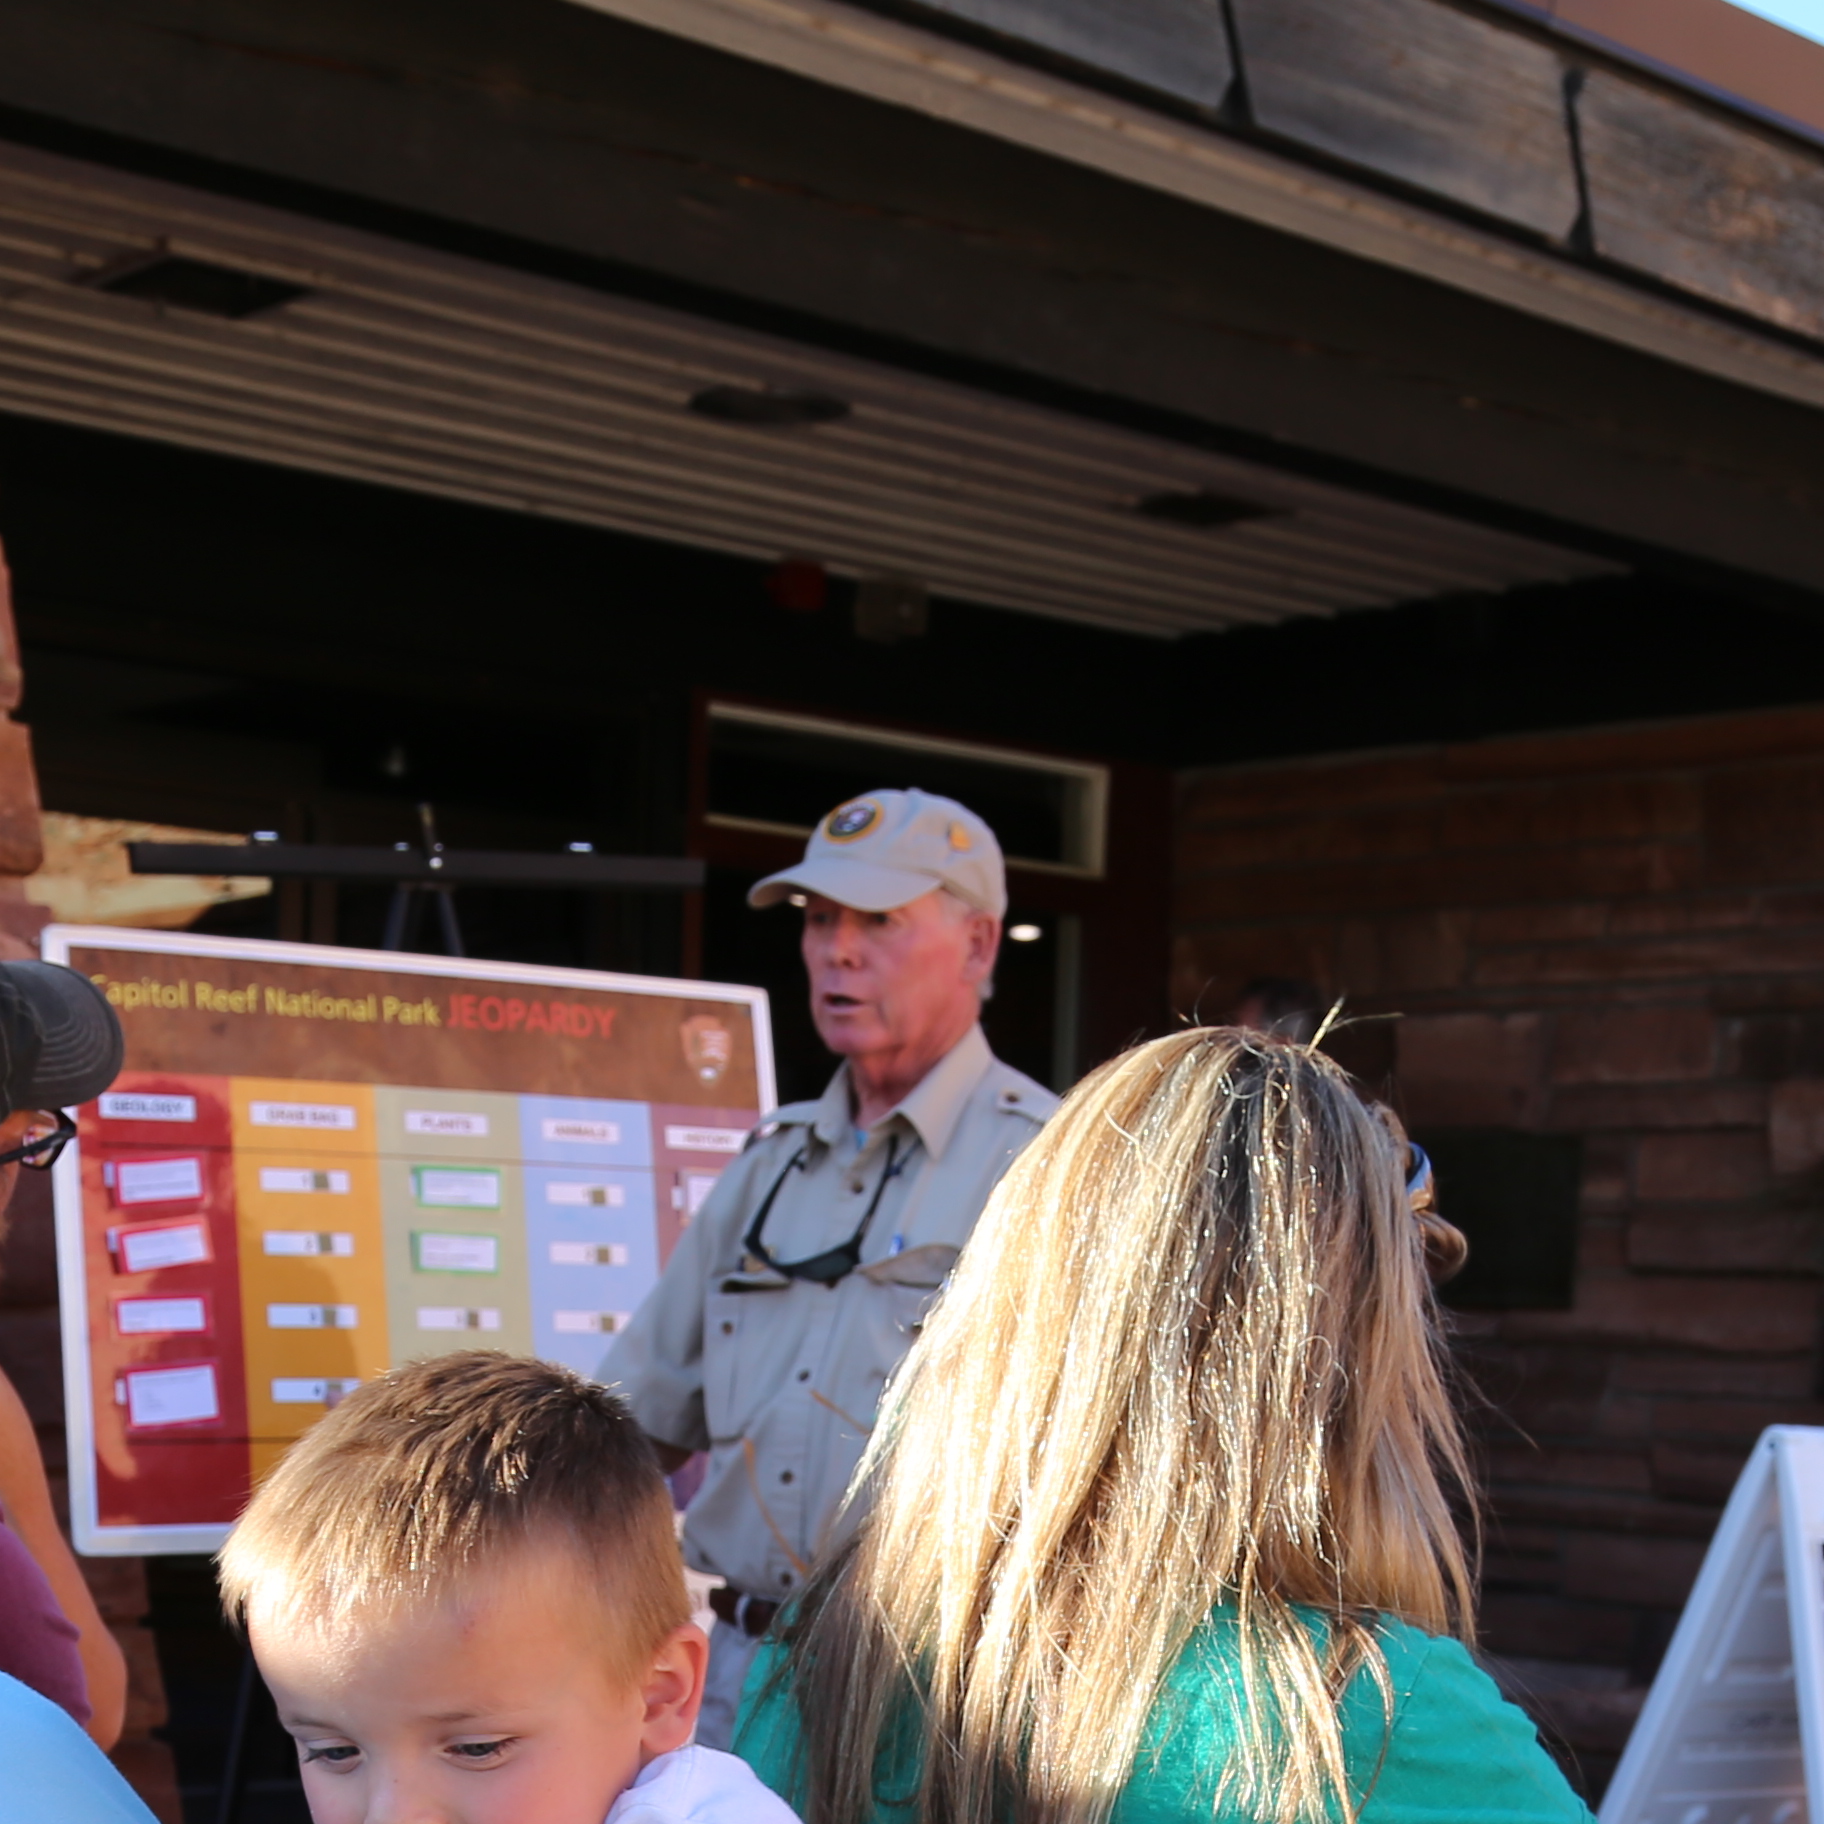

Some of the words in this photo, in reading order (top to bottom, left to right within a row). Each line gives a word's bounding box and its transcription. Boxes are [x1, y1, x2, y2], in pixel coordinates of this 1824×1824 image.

[195, 981, 257, 1012] Reef
[264, 986, 376, 1022] National
[383, 996, 441, 1027] Park
[447, 993, 616, 1038] JEOPARDY
[110, 1099, 184, 1114] GEOLOGY
[420, 1115, 472, 1130] PLANTS
